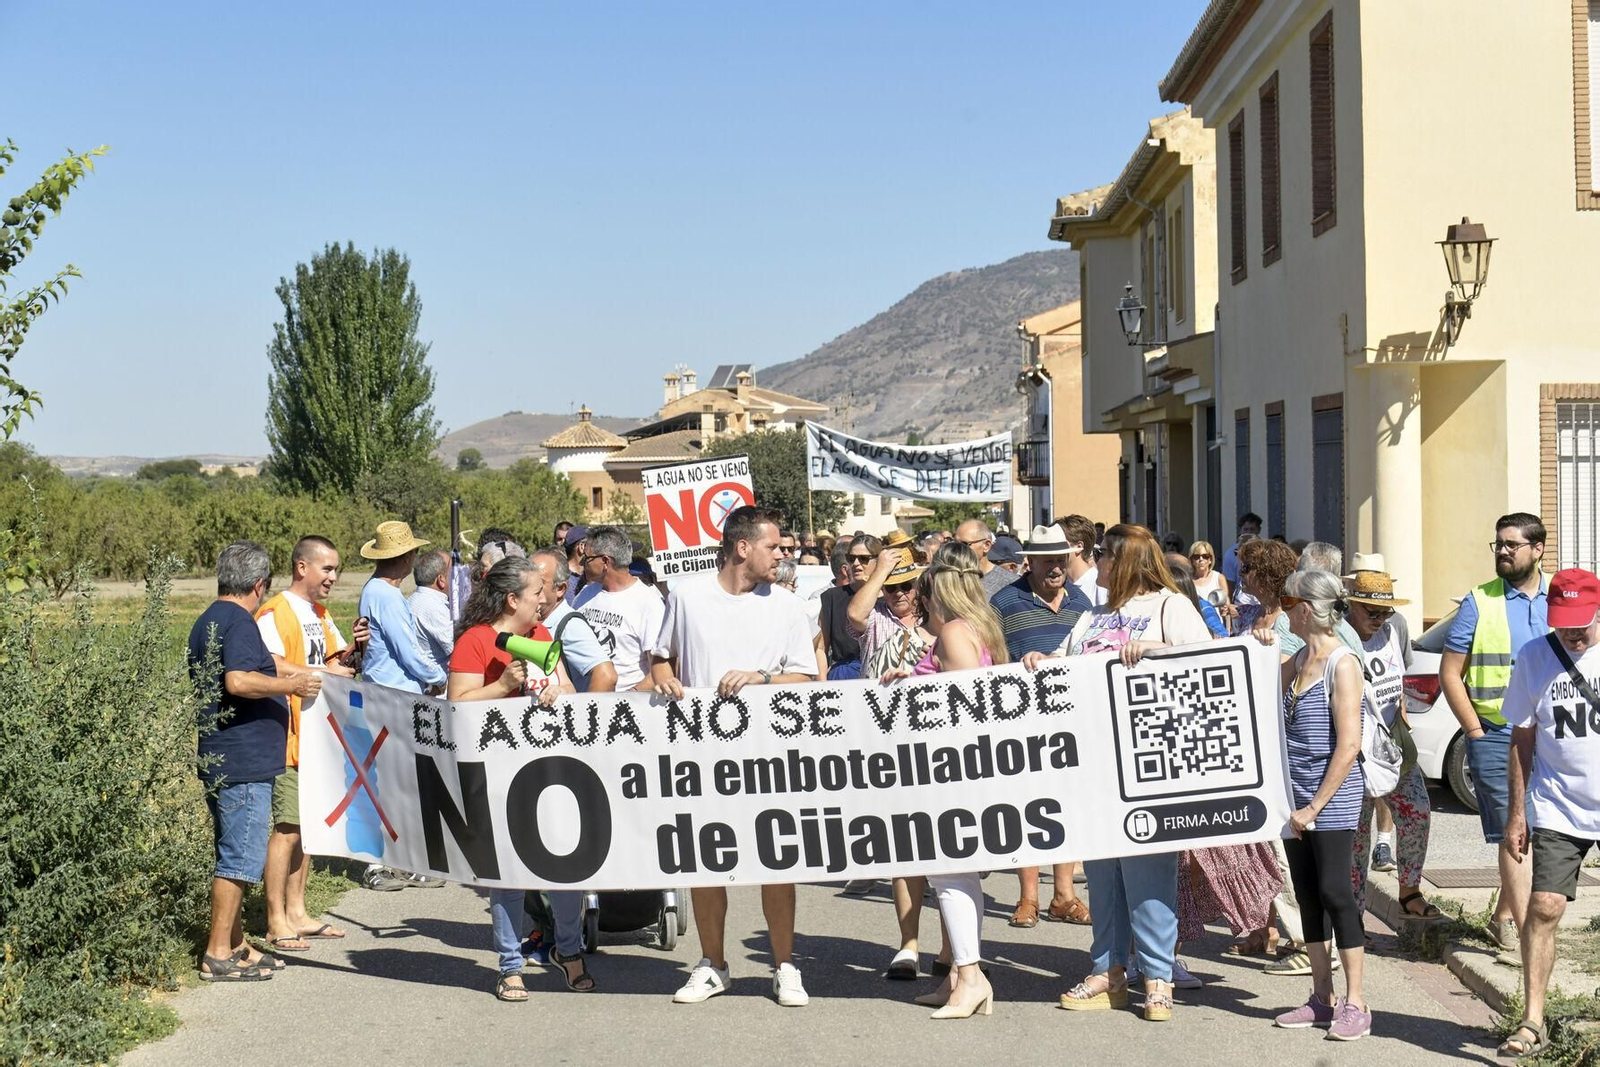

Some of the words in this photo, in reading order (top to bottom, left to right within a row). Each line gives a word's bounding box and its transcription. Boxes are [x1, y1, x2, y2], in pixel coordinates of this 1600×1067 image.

[844, 438, 893, 460] AGUA
[898, 446, 929, 465] NO
[933, 450, 953, 468] SE
[961, 441, 1012, 464] VENDE
[656, 469, 686, 487] AGUA
[688, 466, 703, 483] NO
[705, 464, 719, 480] SE
[811, 456, 830, 478] EL
[831, 457, 870, 480] AGUA
[878, 465, 900, 489] SE
[914, 467, 1004, 495] DEFIENDE
[646, 482, 757, 552] NO
[655, 554, 662, 562] a
[663, 552, 672, 561] la
[663, 562, 680, 575] de
[1562, 590, 1579, 599] GAES
[411, 699, 459, 753] EL
[475, 698, 648, 753] AGUA
[664, 694, 752, 744] NO
[769, 690, 847, 739] SE
[863, 665, 1075, 735] VENDE
[620, 762, 648, 799] a
[657, 754, 702, 798] la
[713, 731, 1080, 796] embotelladora
[414, 753, 612, 884] NO
[1163, 813, 1209, 830] FIRMA
[1211, 805, 1250, 825] AQUÍ
[656, 813, 739, 875] de
[754, 797, 1066, 874] Cijancos
